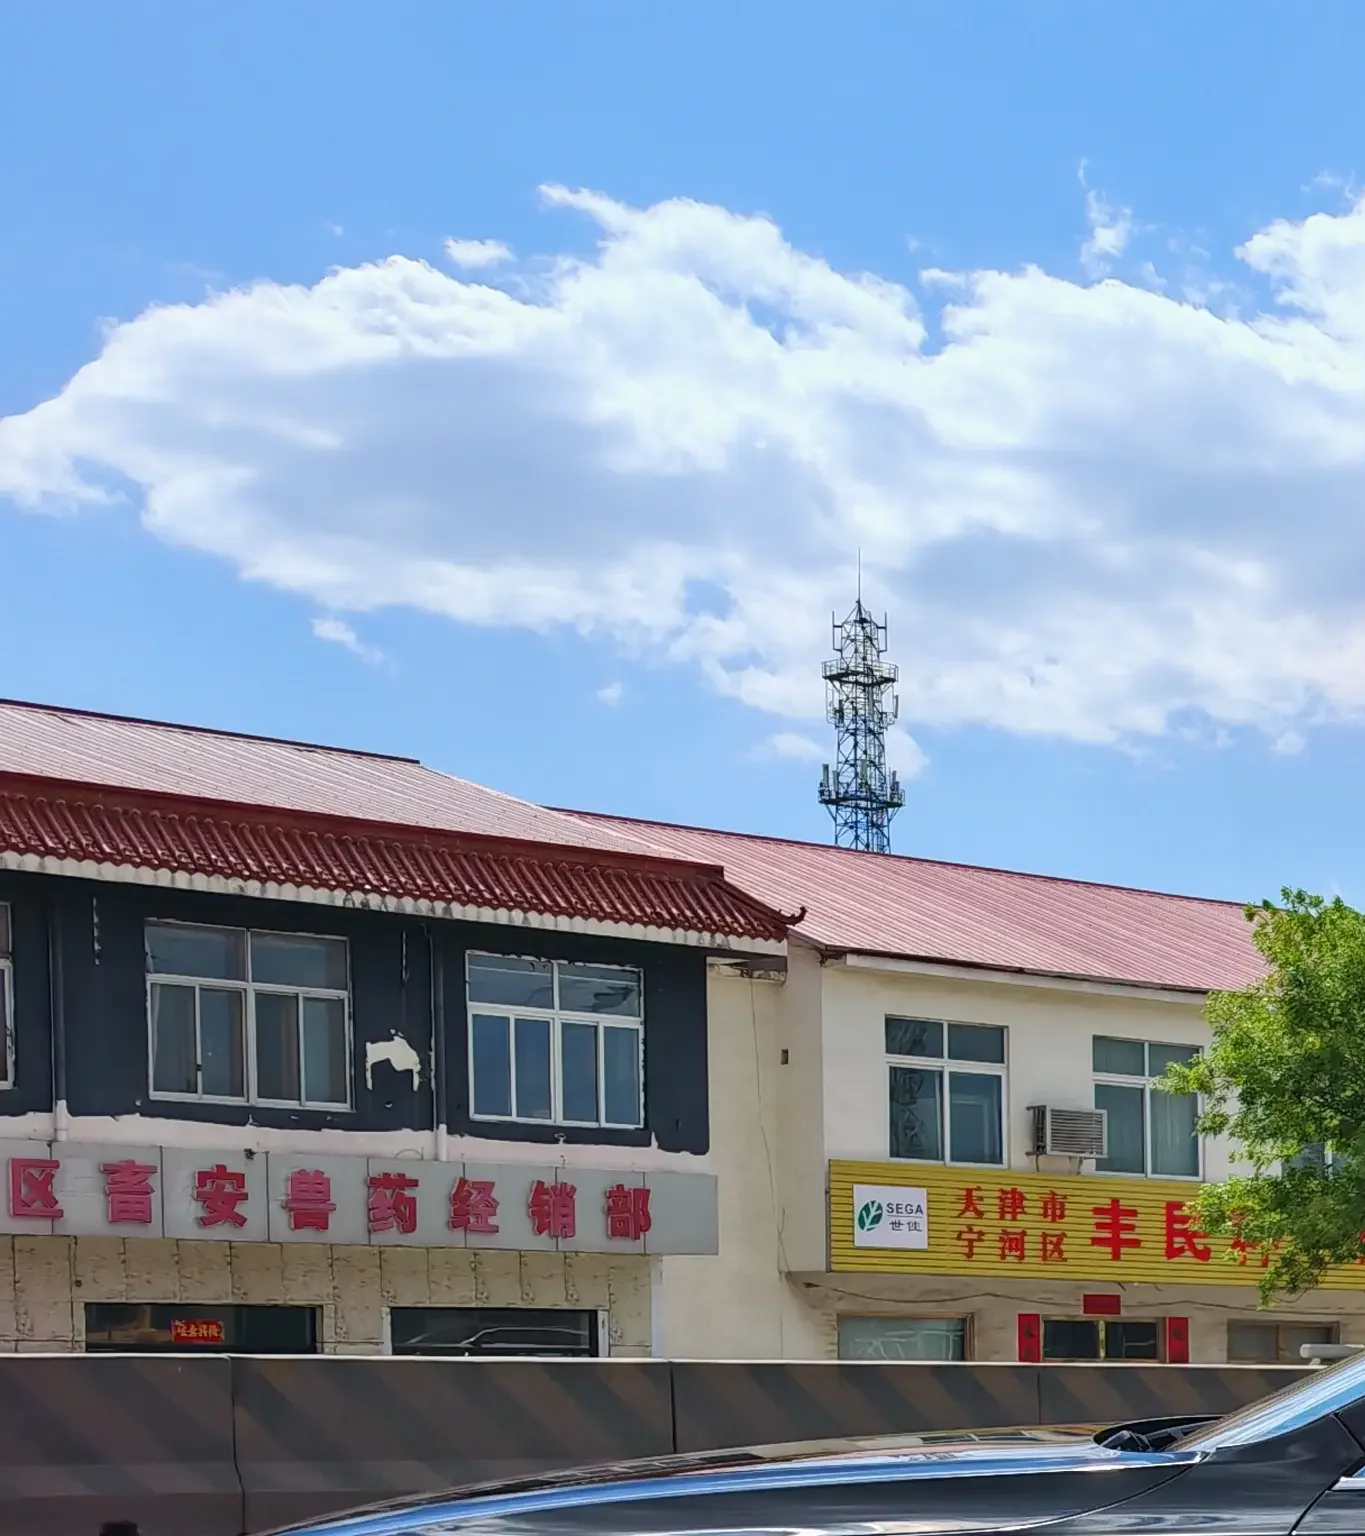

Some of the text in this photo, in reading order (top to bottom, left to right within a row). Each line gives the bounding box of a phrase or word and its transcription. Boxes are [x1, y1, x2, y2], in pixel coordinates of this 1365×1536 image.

[886, 1202, 924, 1216] SEGA
[955, 1186, 1068, 1223] 天津市
[956, 1224, 1068, 1263] 宁河区
